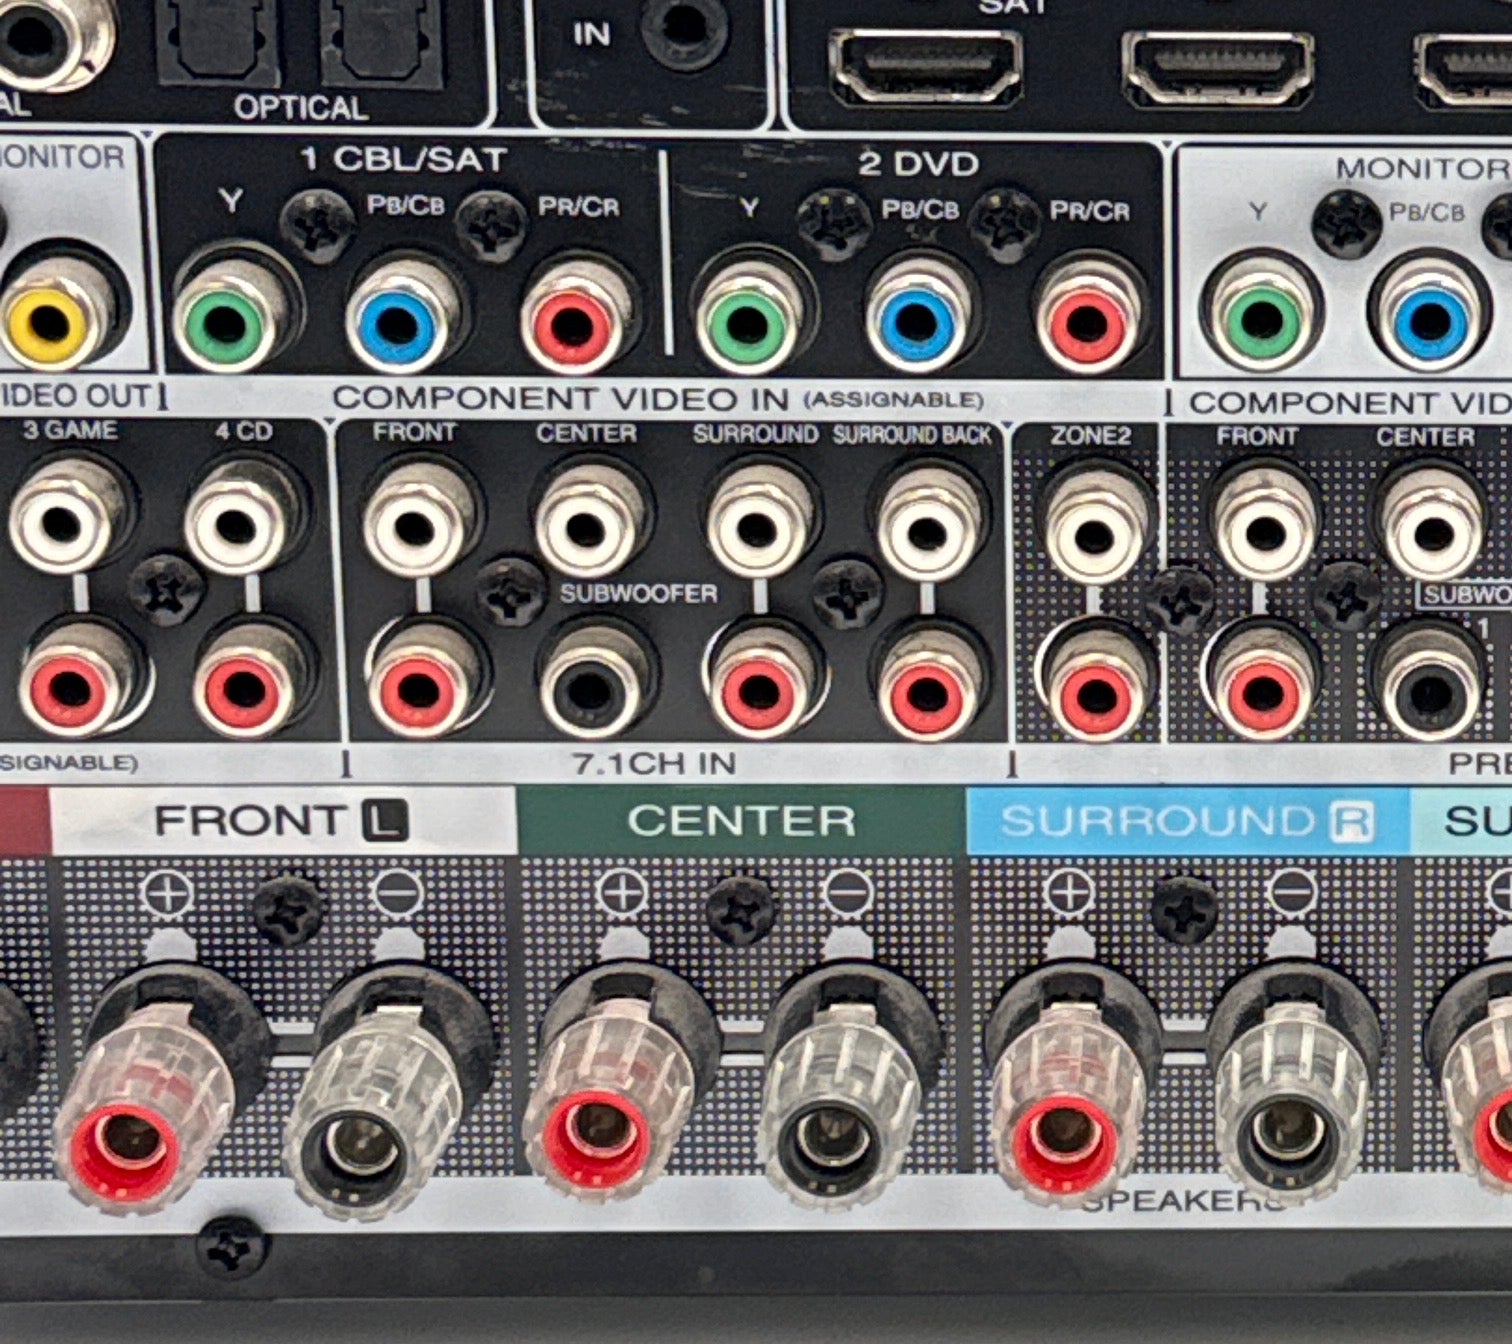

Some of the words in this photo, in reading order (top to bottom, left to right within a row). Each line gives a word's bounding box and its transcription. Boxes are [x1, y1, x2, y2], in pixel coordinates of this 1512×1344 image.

[574, 22, 610, 46] IN
[234, 93, 370, 121] OPTICAL
[0, 143, 125, 169] ONITOR
[300, 146, 316, 171] 1
[333, 145, 508, 173] CBL/SAT
[858, 150, 882, 176] 2
[894, 150, 979, 177] DVD
[1336, 157, 1512, 182] MONITOR
[218, 188, 244, 213] Y
[367, 193, 445, 216] PB/CB
[538, 195, 620, 218] PR/CR
[740, 197, 759, 218] Y
[882, 198, 960, 220] PB/CB
[1050, 199, 1130, 222] PR/CR
[1249, 201, 1268, 221] Y
[1388, 201, 1466, 223] PB/CB
[86, 382, 152, 409] OUT
[332, 384, 600, 411] COMPONENT
[610, 387, 739, 412] VIDEO
[751, 388, 789, 412] IN
[802, 391, 985, 412] (ASSIGNABLE)
[1189, 391, 1441, 415] COMPONENT
[23, 419, 40, 440] 3
[44, 419, 118, 440] GAME
[215, 421, 231, 440] 4
[236, 420, 274, 441] CD
[372, 421, 458, 442] FRONT
[535, 421, 637, 444] CENTER
[693, 423, 820, 444] SURROUND
[832, 423, 938, 445] SURROUND
[941, 425, 993, 445] BACK
[1050, 425, 1132, 446] ZONE2
[1216, 425, 1300, 446] FRONT
[1376, 426, 1476, 447] CENTER
[560, 583, 718, 604] SUBWOOFER
[1477, 617, 1489, 639] 1
[571, 751, 685, 776] 7.1CH
[699, 751, 736, 775] IN
[155, 803, 349, 837] FRONT
[366, 801, 403, 840] L
[628, 804, 856, 837] CENTER
[1001, 804, 1316, 838] SURROUND
[1330, 802, 1374, 840] R
